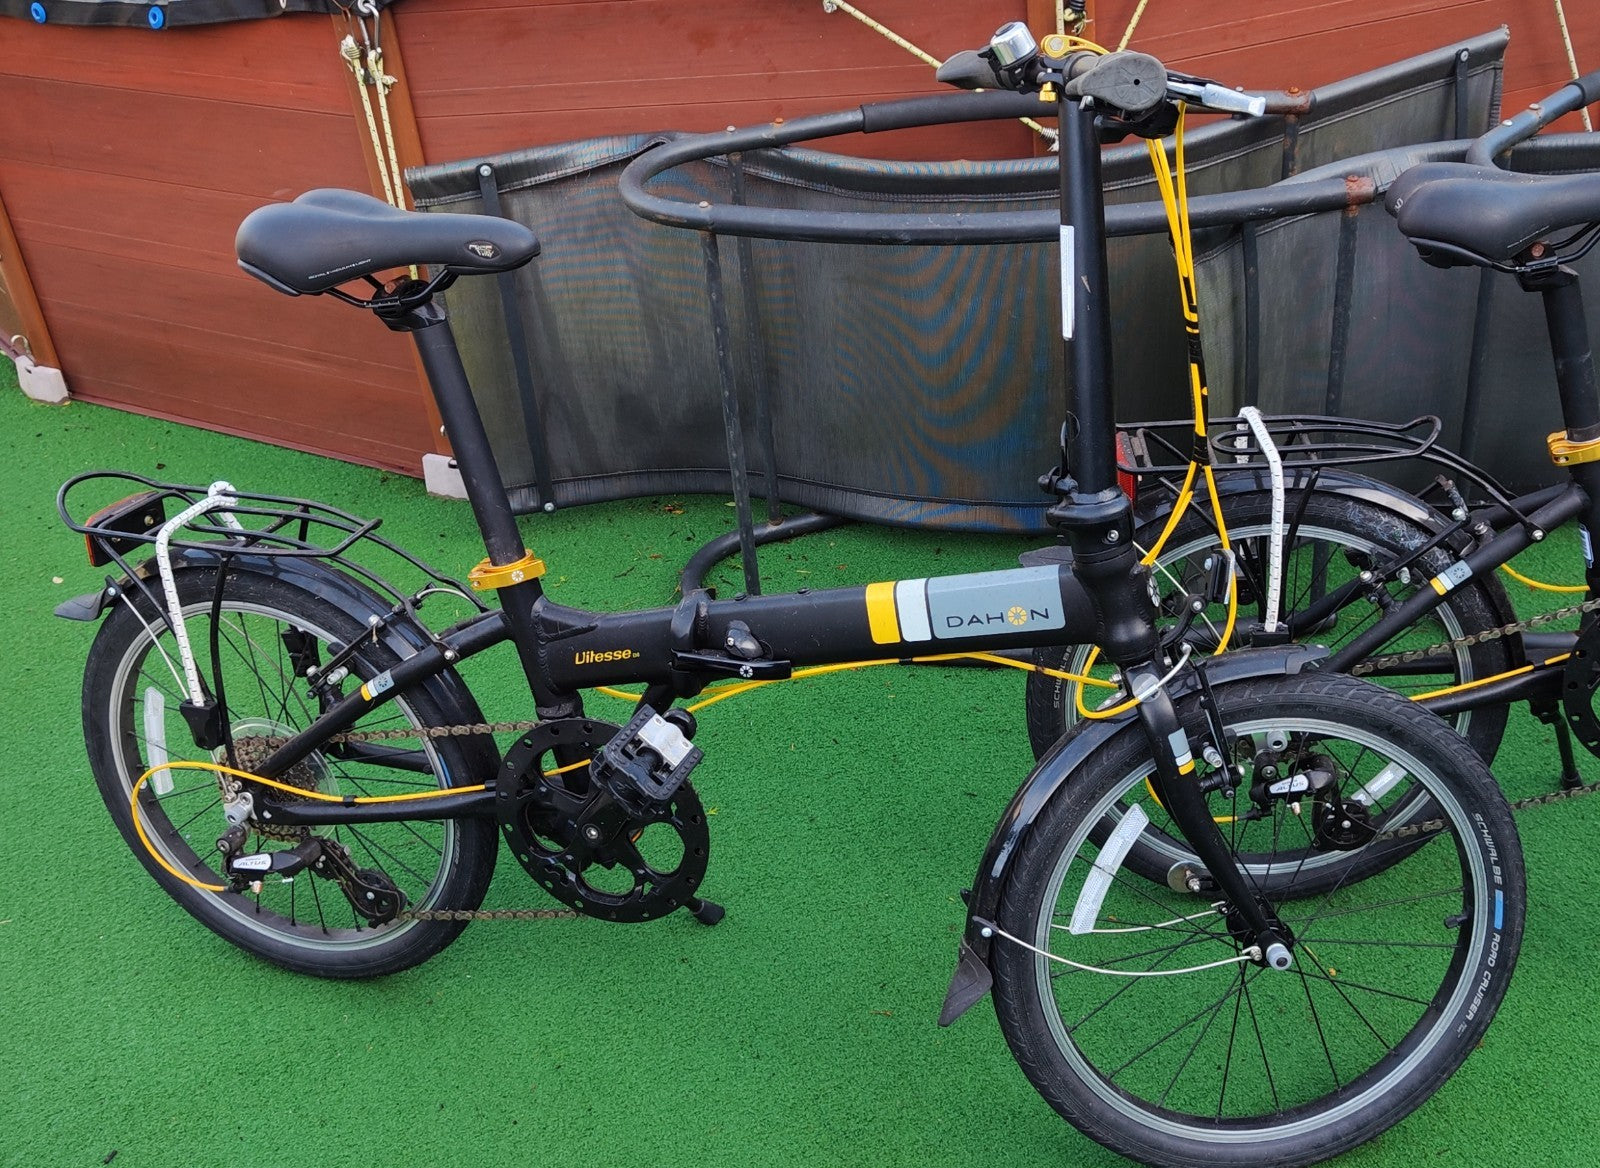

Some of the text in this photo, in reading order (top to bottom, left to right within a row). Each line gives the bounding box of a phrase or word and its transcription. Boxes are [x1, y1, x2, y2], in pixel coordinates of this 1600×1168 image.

[946, 607, 1050, 629] DAHON
[1471, 812, 1503, 886] SCHWALBE
[1465, 932, 1501, 1021] ROAD CRUISER
